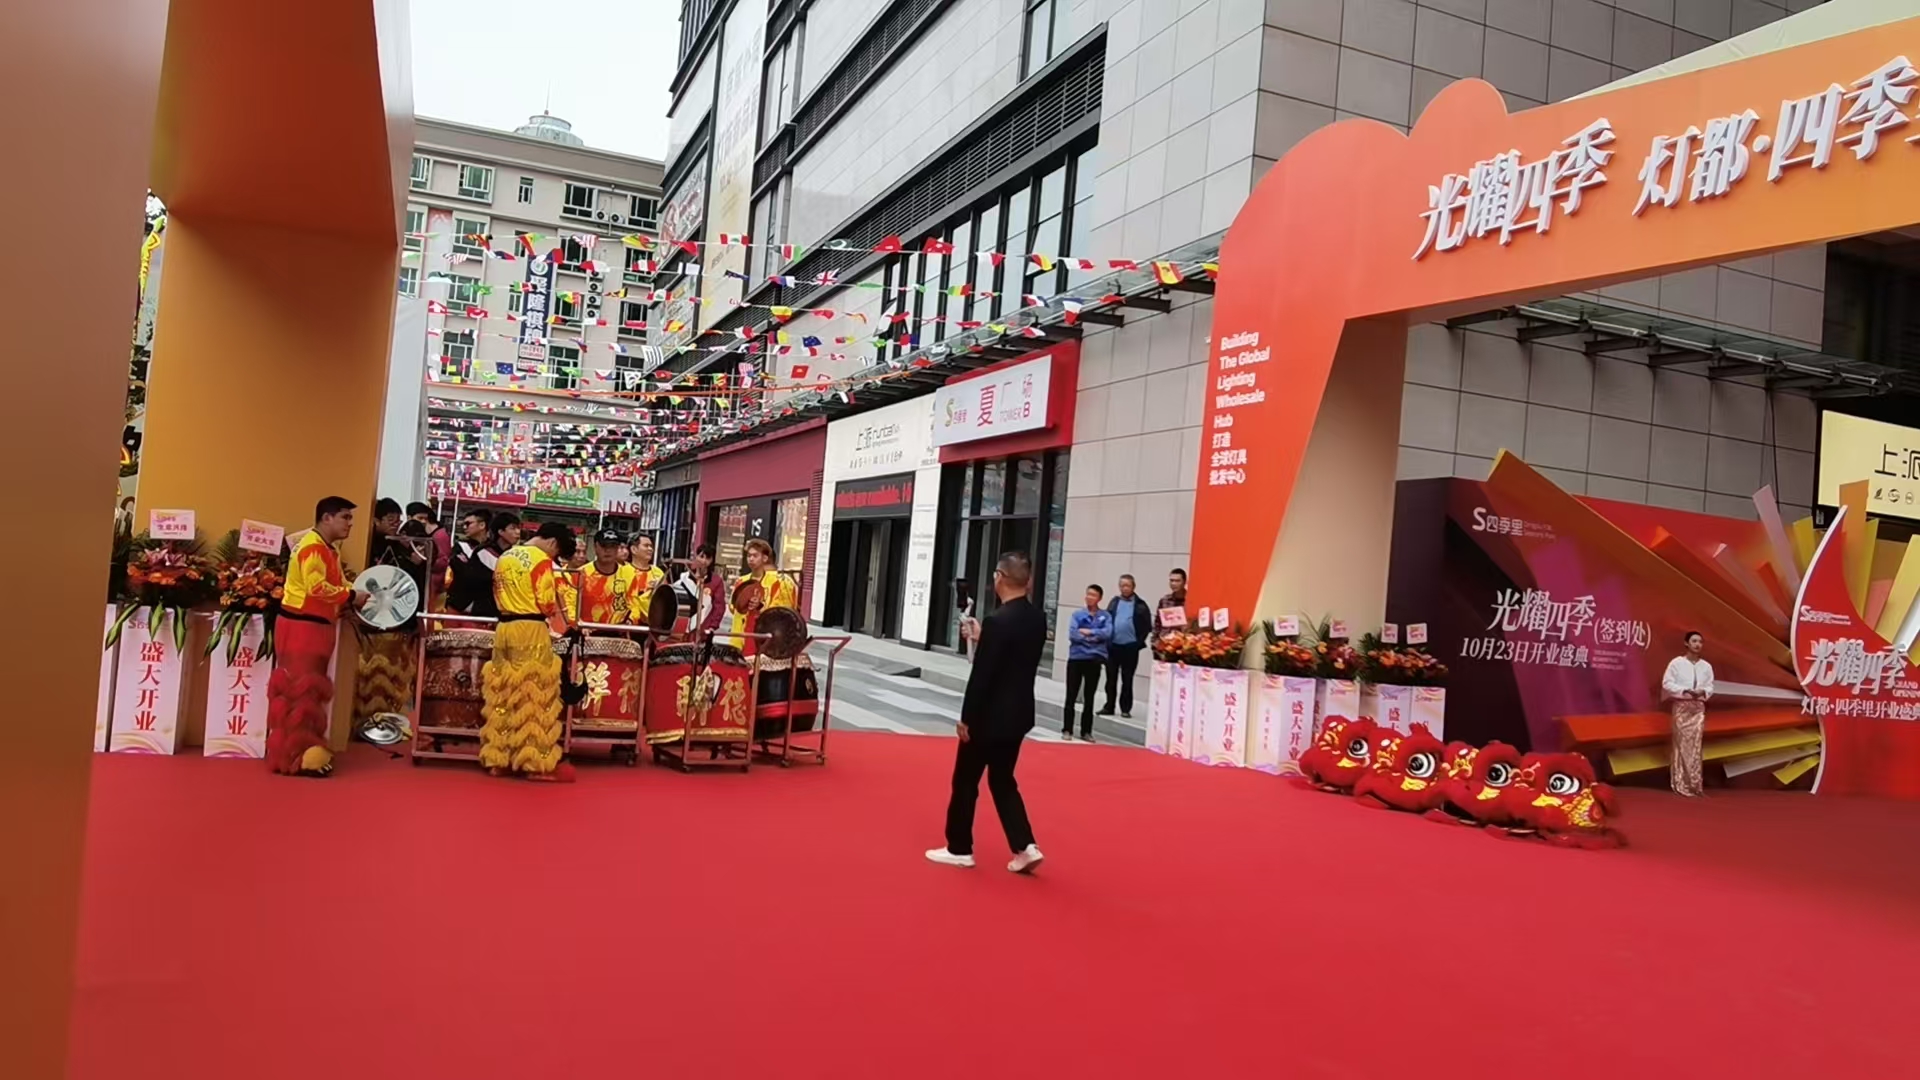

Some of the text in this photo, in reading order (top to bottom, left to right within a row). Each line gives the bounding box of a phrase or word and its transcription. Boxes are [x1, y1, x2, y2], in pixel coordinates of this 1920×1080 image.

[1411, 55, 1920, 260] 光耀四季 灯都·四季
[1220, 345, 1271, 370] The Global
[1221, 331, 1259, 350] Building
[1215, 389, 1265, 409] Wholesale
[1217, 371, 1256, 391] Lighting
[1023, 401, 1031, 418] B
[1213, 413, 1233, 429] Hub
[1487, 587, 1596, 641] 光耀四季
[1460, 637, 1589, 669] 10月23日开业盛典
[1801, 637, 1908, 695] 光耀四季
[134, 641, 164, 731] 盛大开业
[226, 646, 254, 735] 盛大开业
[1223, 692, 1237, 751] 盛大开业
[1289, 701, 1304, 760] 盛大开业
